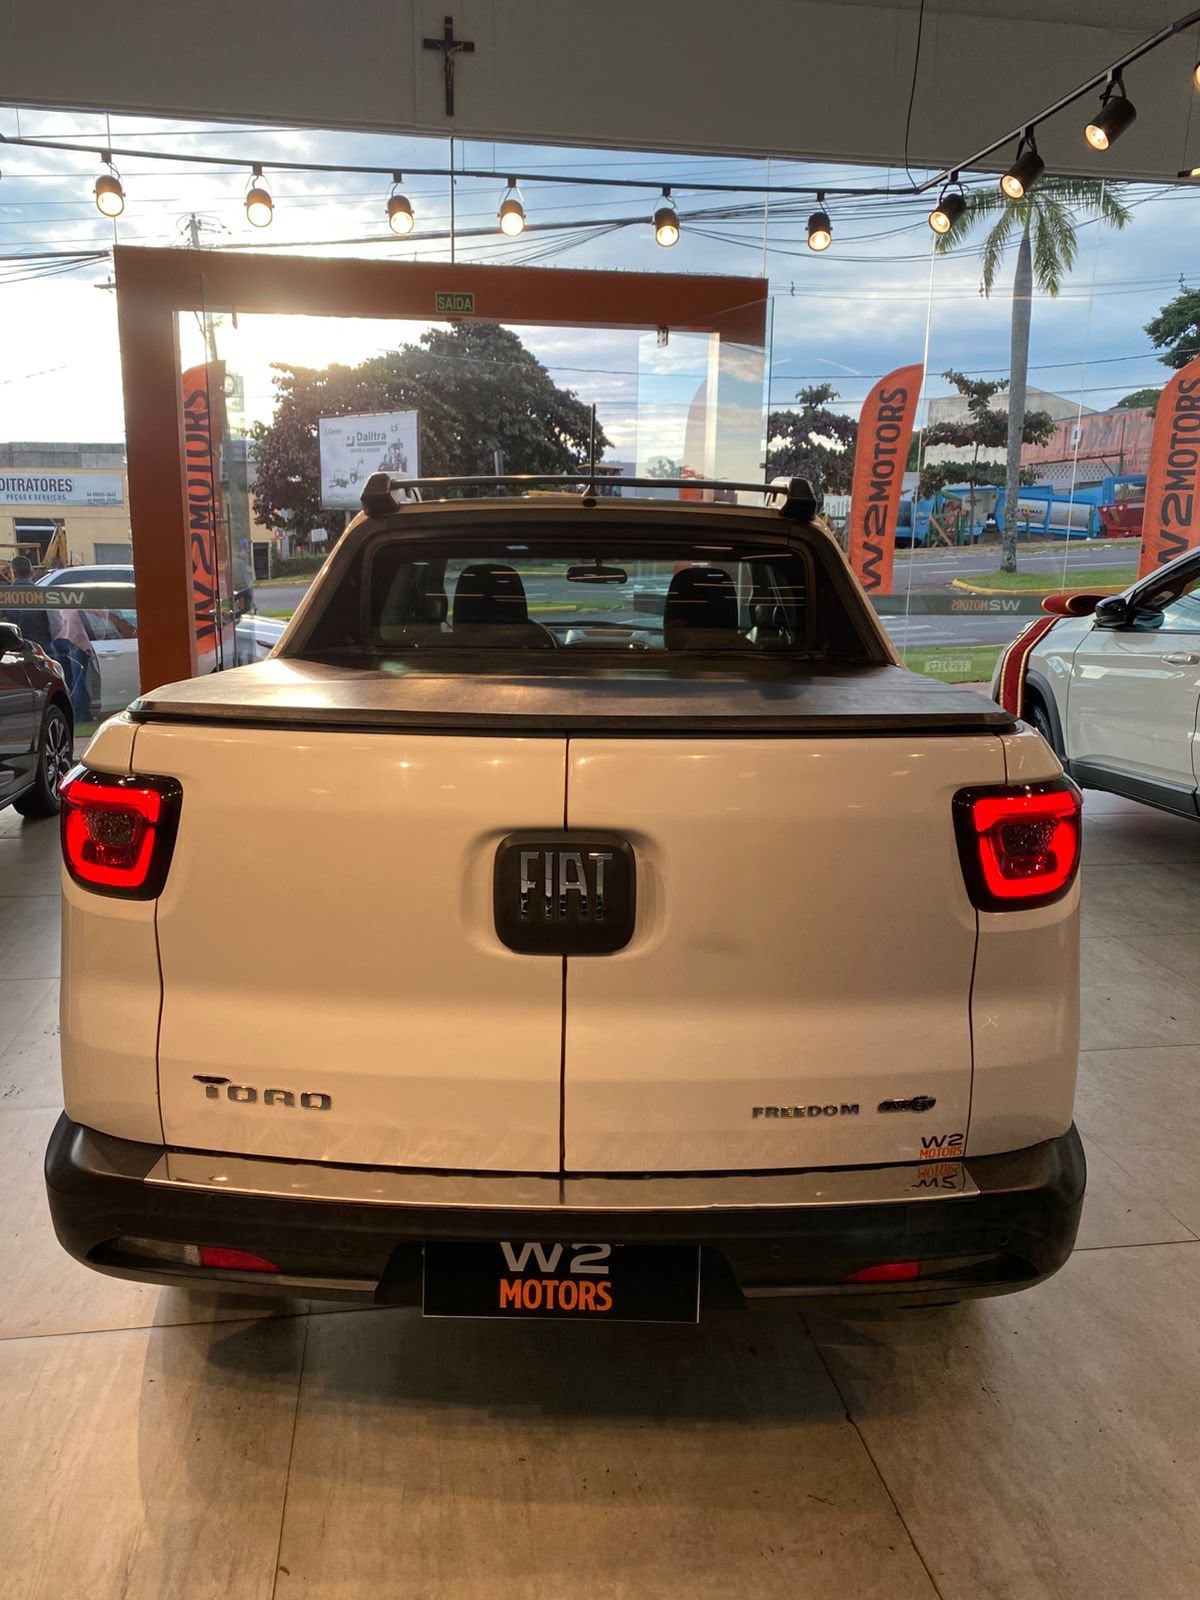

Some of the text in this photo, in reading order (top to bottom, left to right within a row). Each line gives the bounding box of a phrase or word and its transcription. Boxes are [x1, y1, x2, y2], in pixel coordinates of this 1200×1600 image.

[438, 294, 472, 311] SAÍDA
[520, 852, 613, 920] FIAT
[192, 1075, 332, 1109] TORO
[752, 1103, 860, 1119] FREEDOM
[919, 1146, 962, 1159] MOTORS
[921, 1133, 964, 1148] W2
[500, 1242, 612, 1274] W2
[499, 1279, 612, 1311] MOTORS
